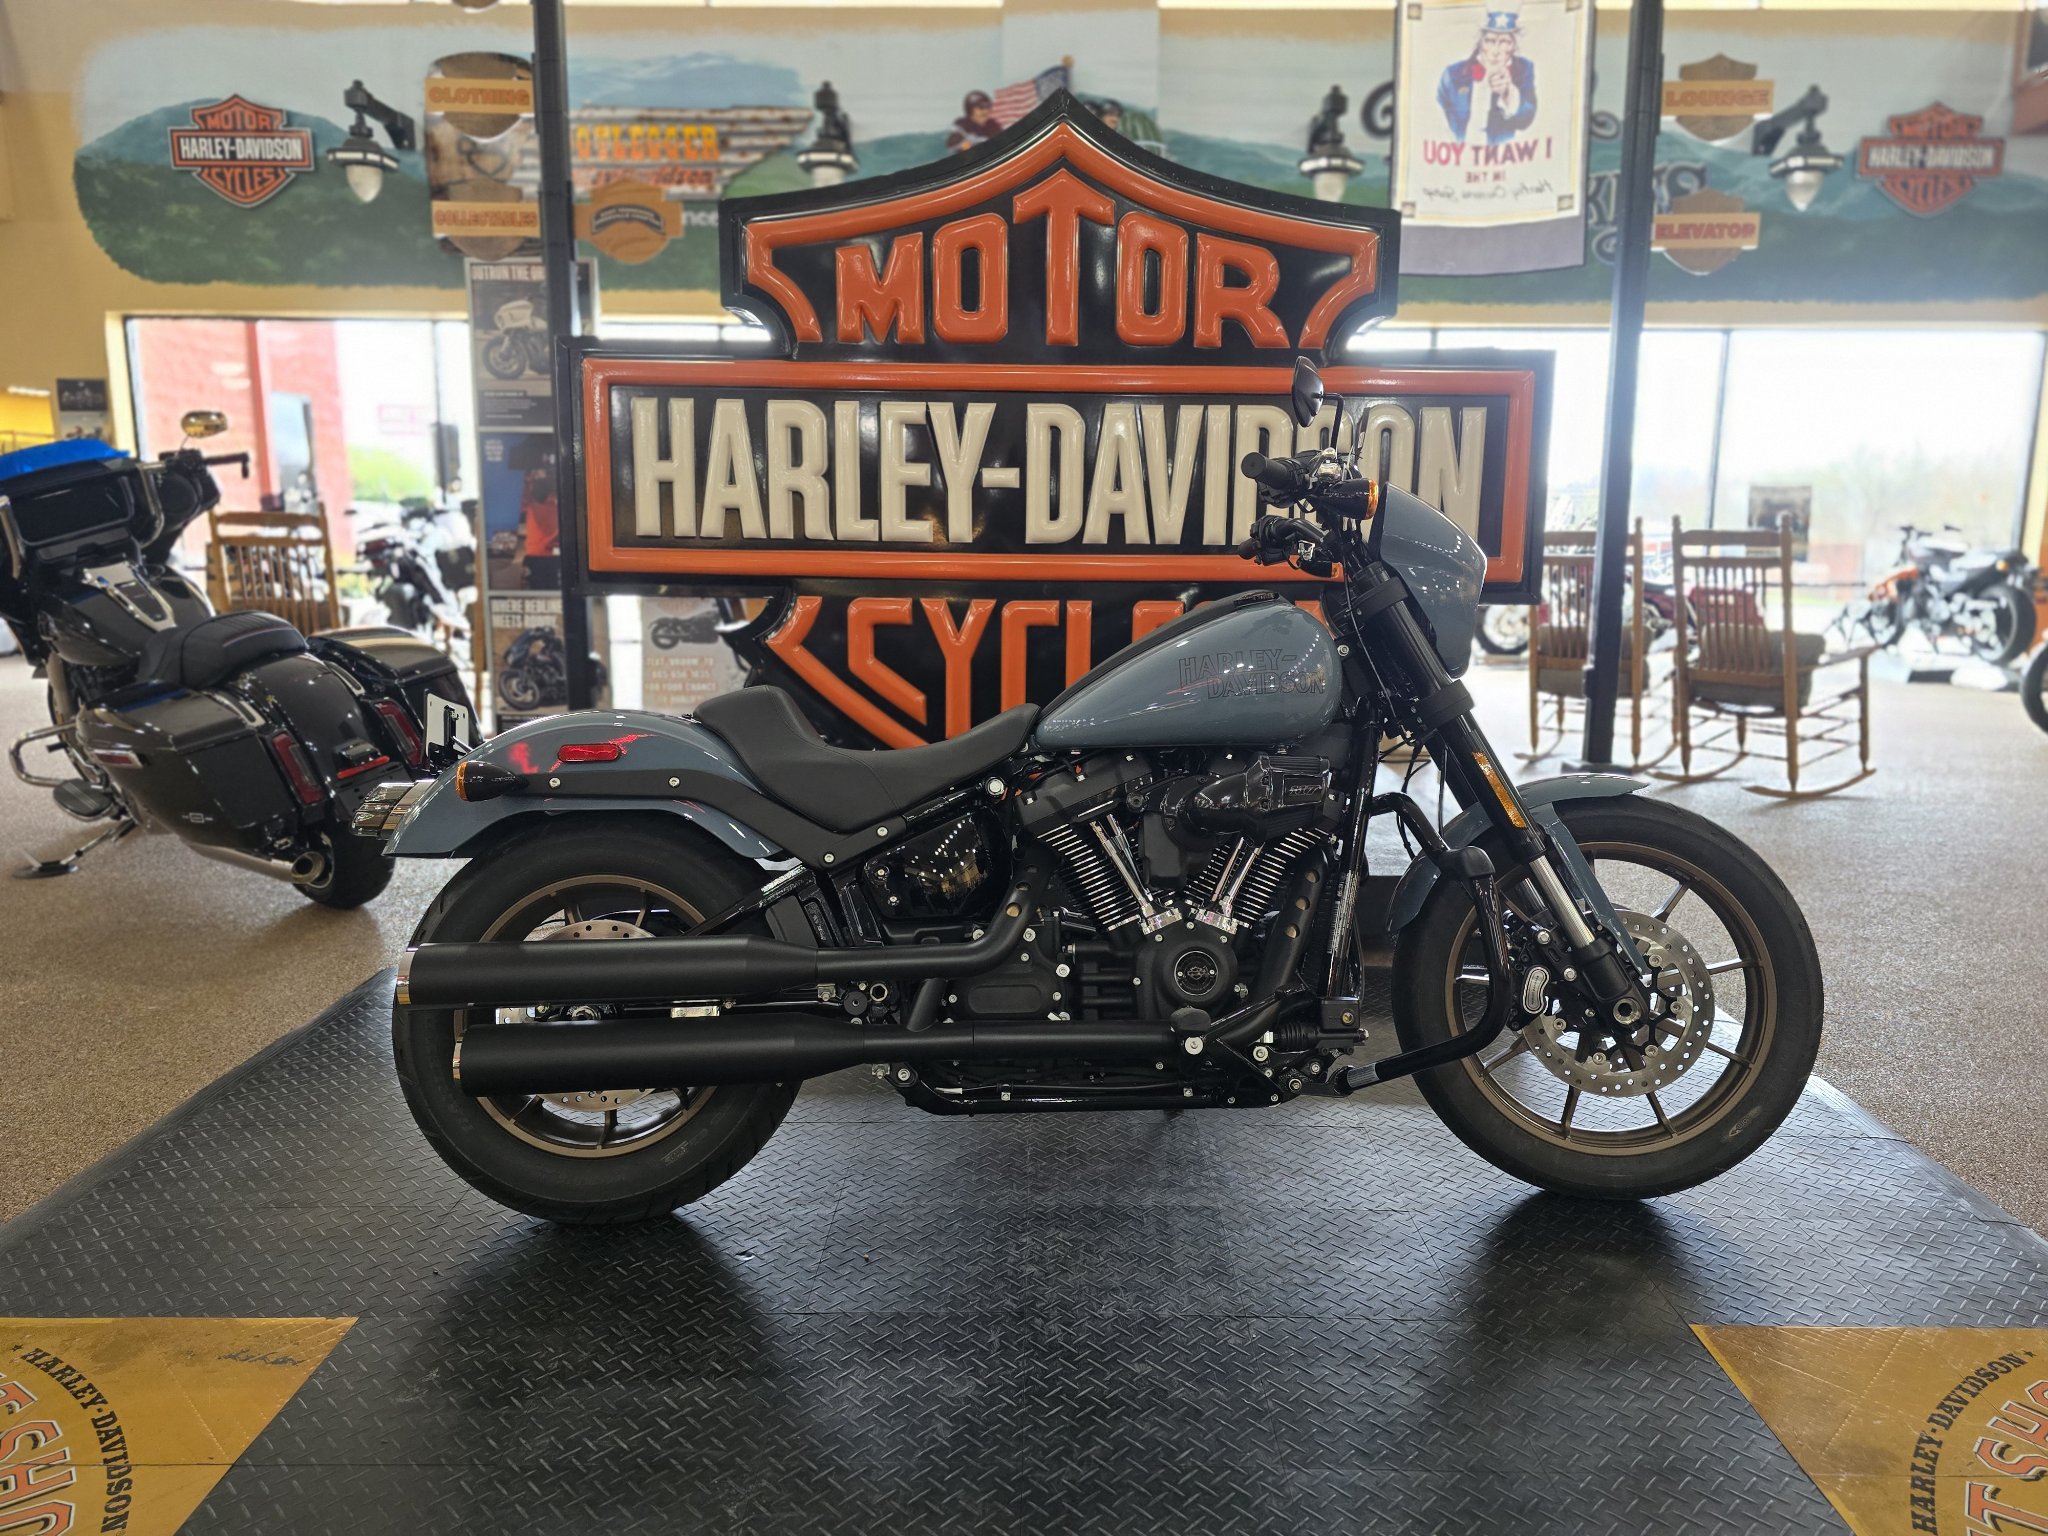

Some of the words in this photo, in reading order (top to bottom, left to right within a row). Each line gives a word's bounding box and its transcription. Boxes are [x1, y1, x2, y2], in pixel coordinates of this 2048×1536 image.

[428, 86, 530, 106] CLOTHING
[1666, 90, 1769, 107] LOUNGE
[205, 106, 272, 129] MOTOR
[180, 136, 303, 160] HARLEY-DAVIDSON
[211, 168, 275, 196] CYCLES
[1655, 222, 1755, 240] ELEVATOR
[836, 167, 1290, 349] MOTOR
[632, 397, 1488, 548] HARLEY-DAVIDON
[847, 597, 1220, 742] CYCL
[1178, 649, 1298, 688] HARLEY-
[1208, 671, 1326, 699] DAVIDSON
